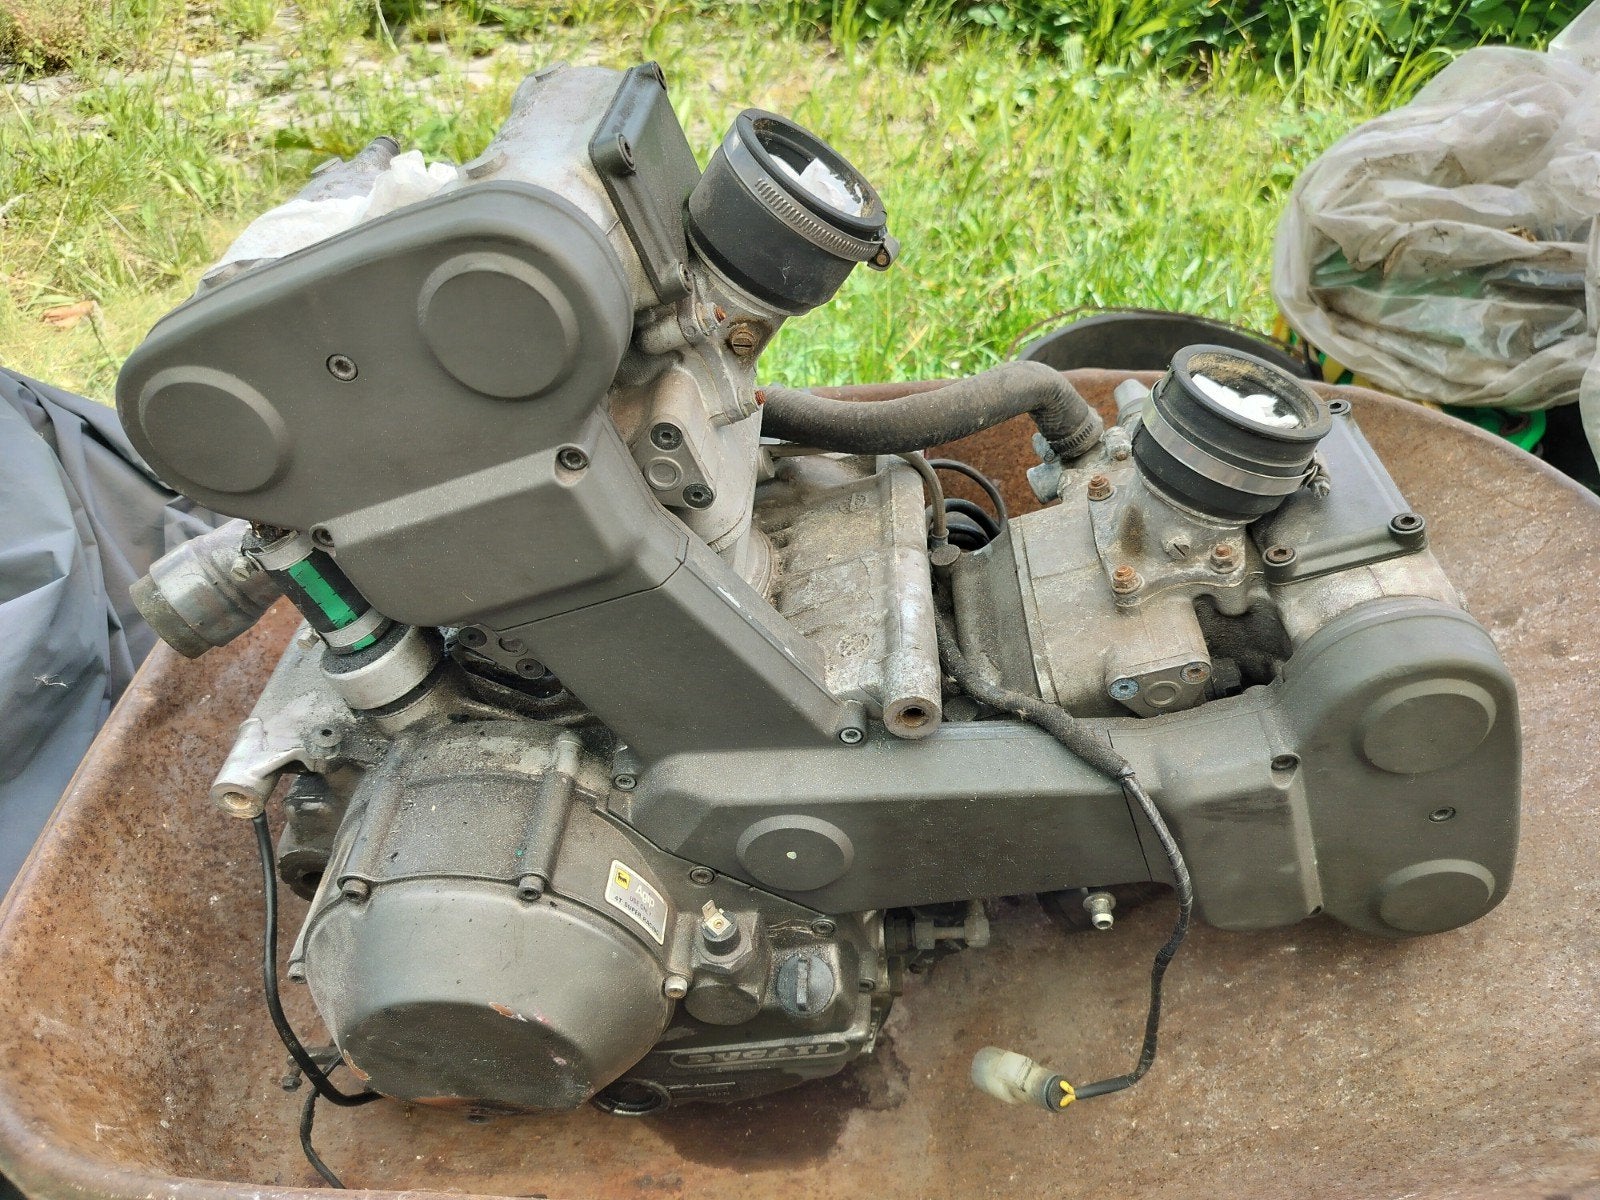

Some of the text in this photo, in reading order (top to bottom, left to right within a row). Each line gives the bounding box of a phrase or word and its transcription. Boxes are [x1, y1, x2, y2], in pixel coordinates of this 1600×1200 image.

[635, 884, 656, 908] Agip
[624, 901, 642, 918] SUPER
[688, 1044, 830, 1065] DUCATI
